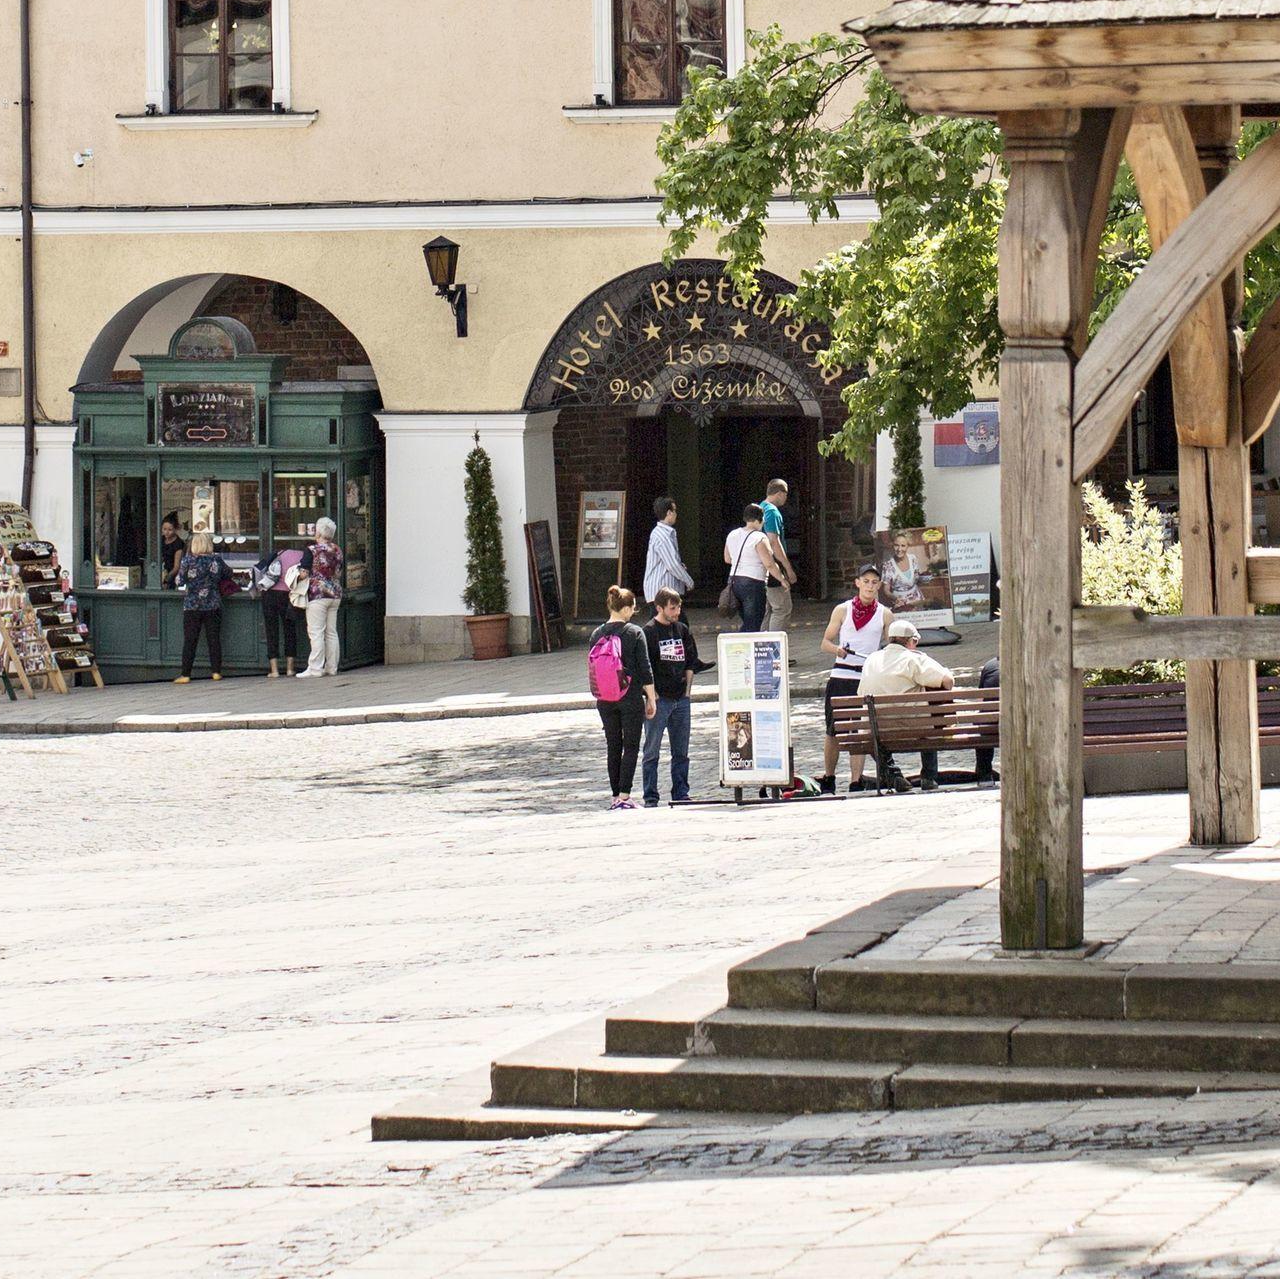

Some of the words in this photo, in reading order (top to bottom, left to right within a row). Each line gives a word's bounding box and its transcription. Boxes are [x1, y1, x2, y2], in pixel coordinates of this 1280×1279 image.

[550, 301, 623, 391] Hotel
[651, 277, 842, 385] Restauraca
[665, 343, 730, 365] 1563
[609, 378, 655, 404] Pod
[671, 371, 787, 405] Ciżemką
